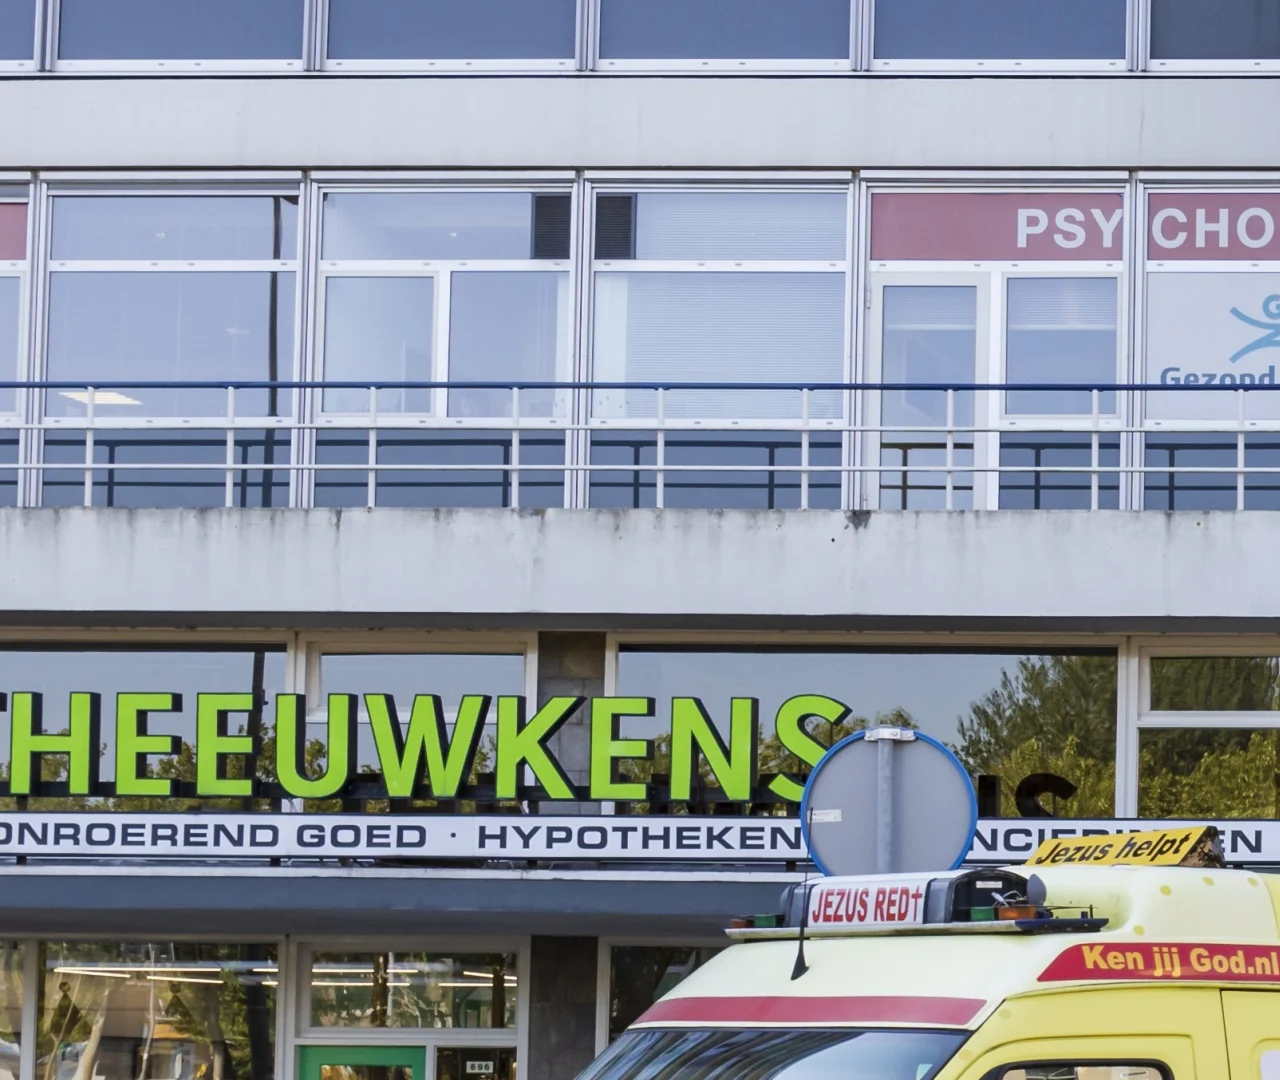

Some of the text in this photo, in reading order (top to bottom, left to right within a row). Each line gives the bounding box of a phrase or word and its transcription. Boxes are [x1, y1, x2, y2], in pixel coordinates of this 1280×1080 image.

[0, 691, 852, 801] HEEUWKENS
[296, 824, 427, 849] GOED
[478, 825, 802, 850] HYPOTHEKEN
[1035, 842, 1114, 865] Jezus
[1115, 832, 1193, 862] helpt
[812, 888, 869, 924] JEZUS
[1081, 944, 1280, 978] Ken jij God.nl
[470, 1063, 490, 1071] 696
